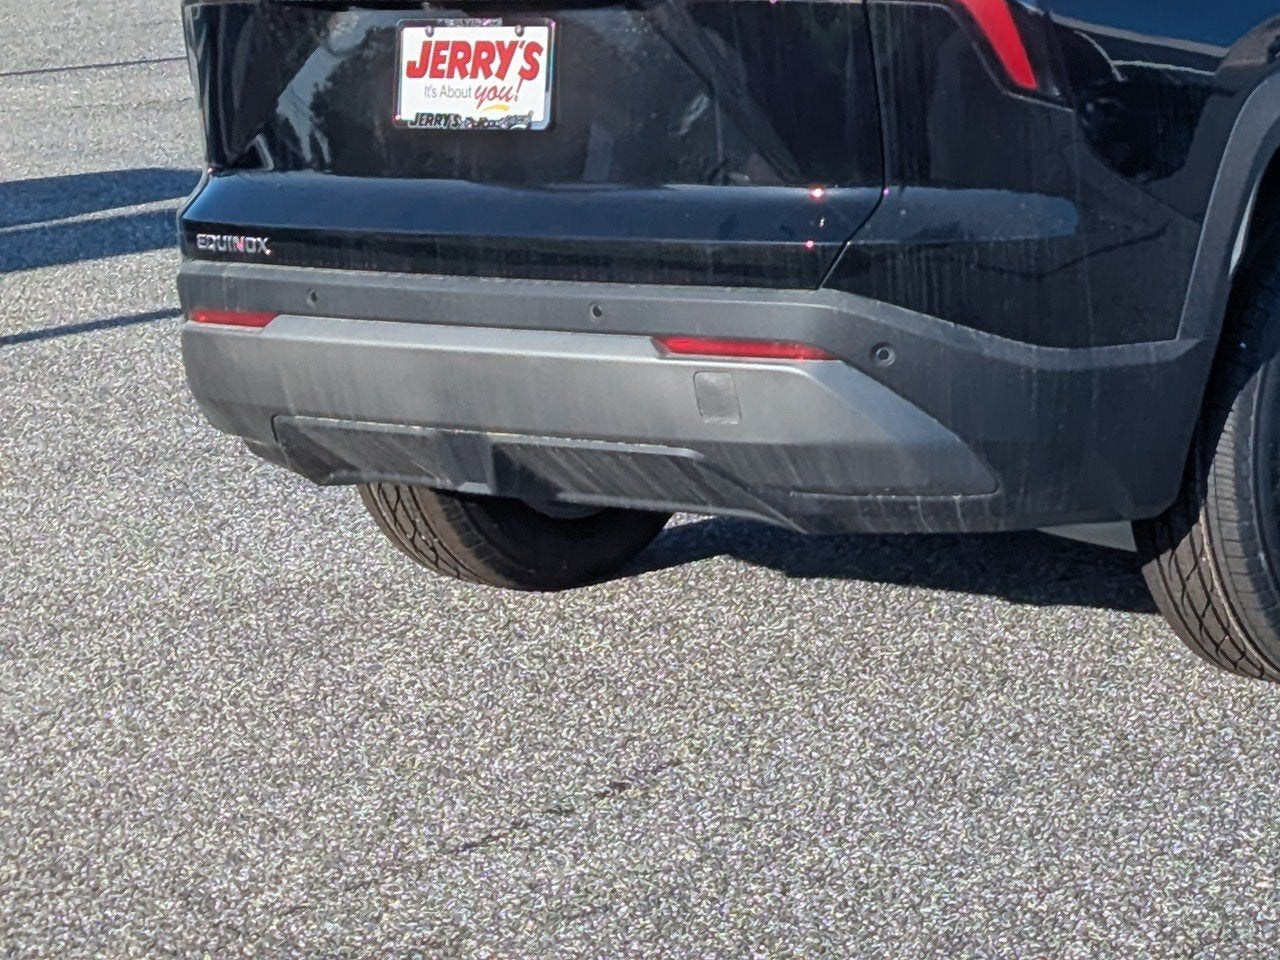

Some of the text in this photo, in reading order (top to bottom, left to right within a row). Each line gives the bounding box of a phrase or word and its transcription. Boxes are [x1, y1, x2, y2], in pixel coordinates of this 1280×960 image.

[405, 40, 544, 81] JERRY'S
[424, 79, 524, 110] It's About you!
[196, 233, 271, 255] EQUINOX
